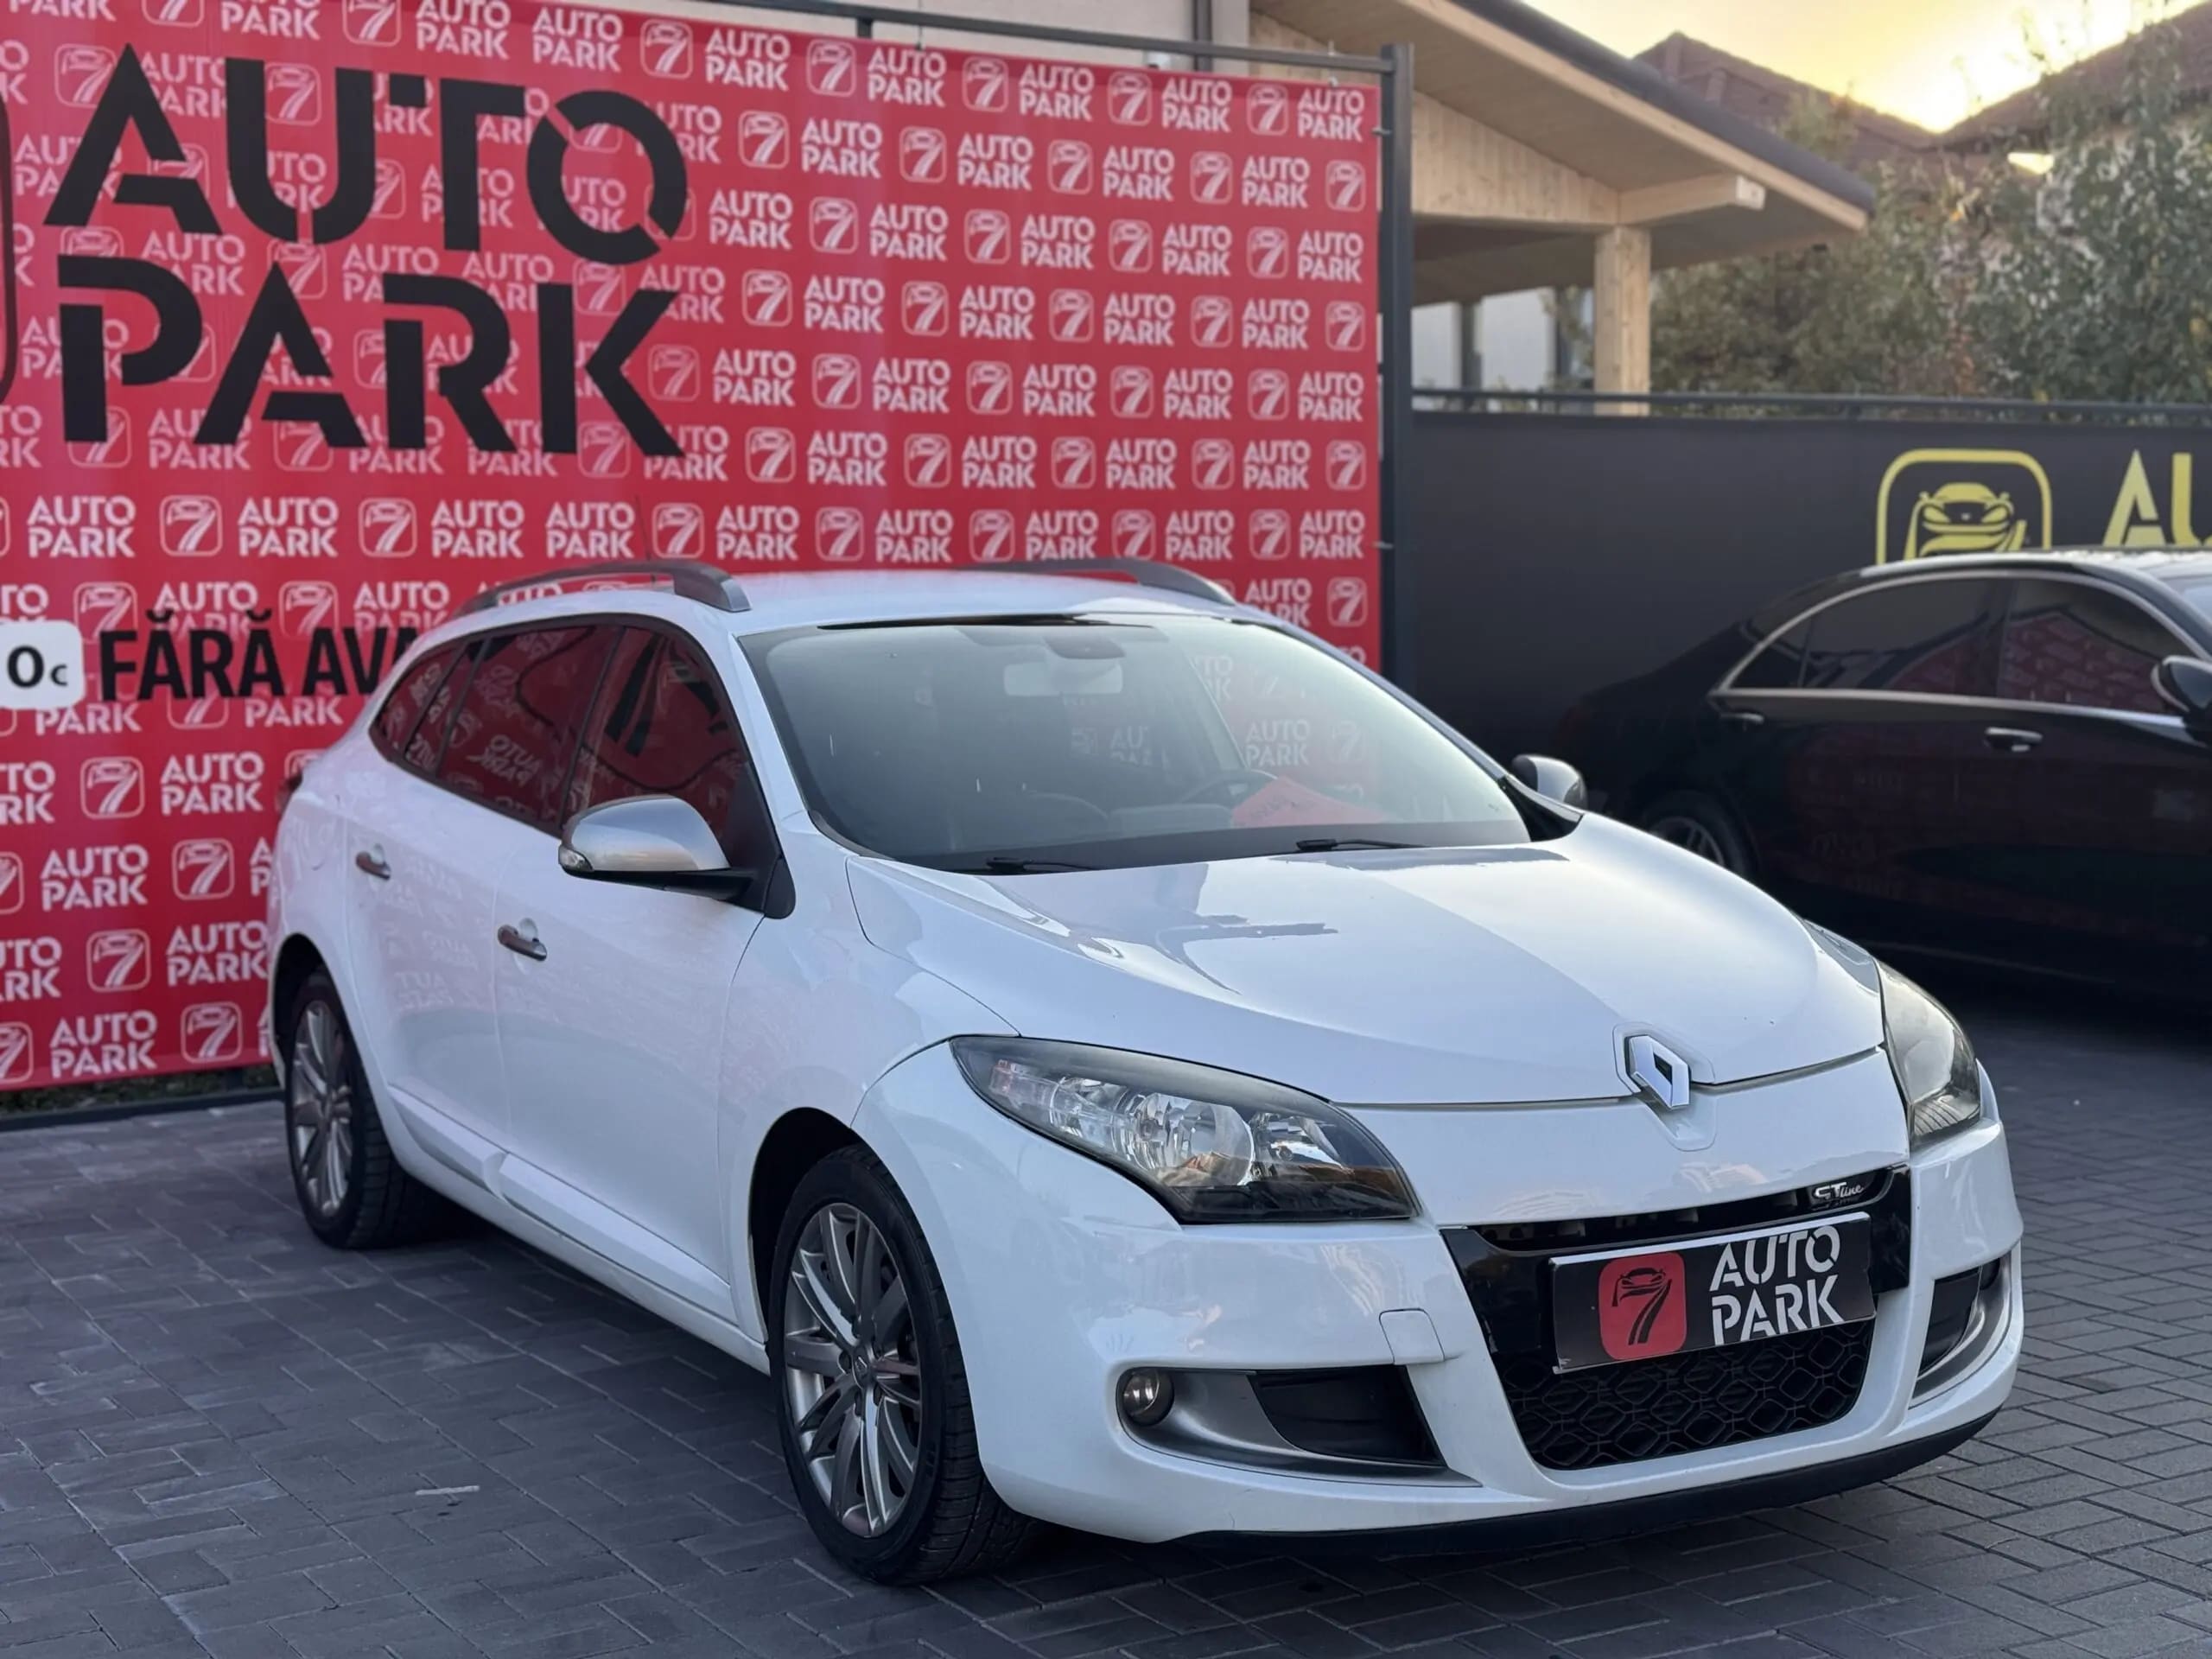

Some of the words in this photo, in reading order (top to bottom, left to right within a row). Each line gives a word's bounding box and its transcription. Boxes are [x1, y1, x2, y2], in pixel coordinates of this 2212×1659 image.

[221, 3, 321, 40] PARK
[416, 0, 511, 28] AUTO
[532, 10, 624, 41] AUTO
[416, 20, 508, 60] PARK
[533, 35, 620, 71] PARK
[705, 28, 791, 60] AUTO
[705, 54, 788, 91] PARK
[868, 45, 948, 78] AUTO
[867, 73, 944, 106] PARK
[1019, 61, 1096, 92] AUTO
[1162, 76, 1234, 106] AUTO
[1019, 88, 1091, 120] PARK
[1298, 87, 1364, 116] AUTO
[1162, 103, 1230, 131] PARK
[1298, 112, 1361, 141] PARK
[802, 118, 882, 149] AUTO
[957, 134, 1034, 162] AUTO
[43, 42, 689, 265] AUTO
[802, 144, 880, 179] PARK
[1103, 147, 1175, 175] AUTO
[957, 157, 1031, 190] PARK
[1243, 156, 1310, 182] AUTO
[1103, 170, 1172, 200] PARK
[1242, 180, 1306, 207] PARK
[709, 190, 793, 220] AUTO
[869, 204, 948, 234] AUTO
[710, 215, 791, 249] PARK
[1021, 215, 1096, 242] AUTO
[1163, 225, 1232, 251] AUTO
[141, 231, 246, 264] AUTO
[870, 229, 945, 260] PARK
[1020, 240, 1092, 269] PARK
[1298, 232, 1363, 257] AUTO
[343, 245, 439, 275] AUTO
[462, 251, 554, 283] AUTO
[1162, 248, 1229, 276] PARK
[1298, 256, 1361, 282] PARK
[639, 263, 725, 295] AUTO
[804, 276, 885, 304] AUTO
[662, 293, 724, 323] ARK
[960, 286, 1034, 313] AUTO
[1104, 294, 1175, 319] AUTO
[1243, 299, 1310, 325] AUTO
[804, 302, 883, 333] PARK
[960, 310, 1033, 340] PARK
[1104, 316, 1173, 345] PARK
[1243, 323, 1308, 348] PARK
[57, 255, 688, 459] PARK
[714, 350, 796, 378] AUTO
[873, 359, 950, 386] AUTO
[1023, 365, 1096, 392] AUTO
[1164, 369, 1233, 394] AUTO
[1299, 372, 1363, 397] AUTO
[714, 375, 794, 406] PARK
[873, 384, 948, 412] PARK
[1023, 389, 1094, 416] PARK
[1164, 394, 1230, 418] PARK
[1299, 395, 1362, 420] PARK
[149, 439, 251, 471] PARK
[349, 445, 443, 474] PARK
[808, 432, 887, 458] AUTO
[963, 435, 1037, 461] AUTO
[1106, 439, 1177, 463] AUTO
[1244, 440, 1311, 464] AUTO
[643, 451, 729, 481] PARK
[808, 456, 886, 486] PARK
[963, 461, 1035, 488] PARK
[1106, 463, 1175, 488] PARK
[1243, 464, 1308, 488] PARK
[28, 496, 136, 526] AUTO
[238, 498, 339, 527] AUTO
[431, 500, 524, 529] AUTO
[546, 502, 634, 531] AUTO
[716, 505, 799, 532] AUTO
[875, 510, 953, 537] AUTO
[1026, 511, 1098, 536] AUTO
[1166, 510, 1234, 536] AUTO
[1300, 510, 1364, 535] AUTO
[29, 526, 134, 557] PARK
[238, 525, 337, 556] PARK
[432, 527, 523, 557] PARK
[547, 529, 633, 558] PARK
[717, 531, 797, 560] PARK
[876, 535, 950, 563] PARK
[1025, 535, 1096, 561] PARK
[1166, 534, 1231, 560] PARK
[1300, 533, 1363, 558] PARK
[153, 581, 258, 613] AUTO
[353, 581, 450, 612] AUTO
[1245, 578, 1313, 604] AUTO
[99, 608, 287, 702] FĂRĂ
[35, 702, 142, 735] PARK
[245, 696, 343, 728] PARK
[161, 751, 264, 785] AUTO
[162, 781, 263, 815] PARK
[41, 844, 149, 880] AUTO
[41, 874, 147, 911] PARK
[166, 919, 270, 957] AUTO
[168, 950, 269, 987] PARK
[50, 1010, 157, 1049] AUTO
[52, 1040, 157, 1078] PARK
[1709, 1225, 1840, 1292] AUTO
[1712, 1274, 1845, 1346] PARK
